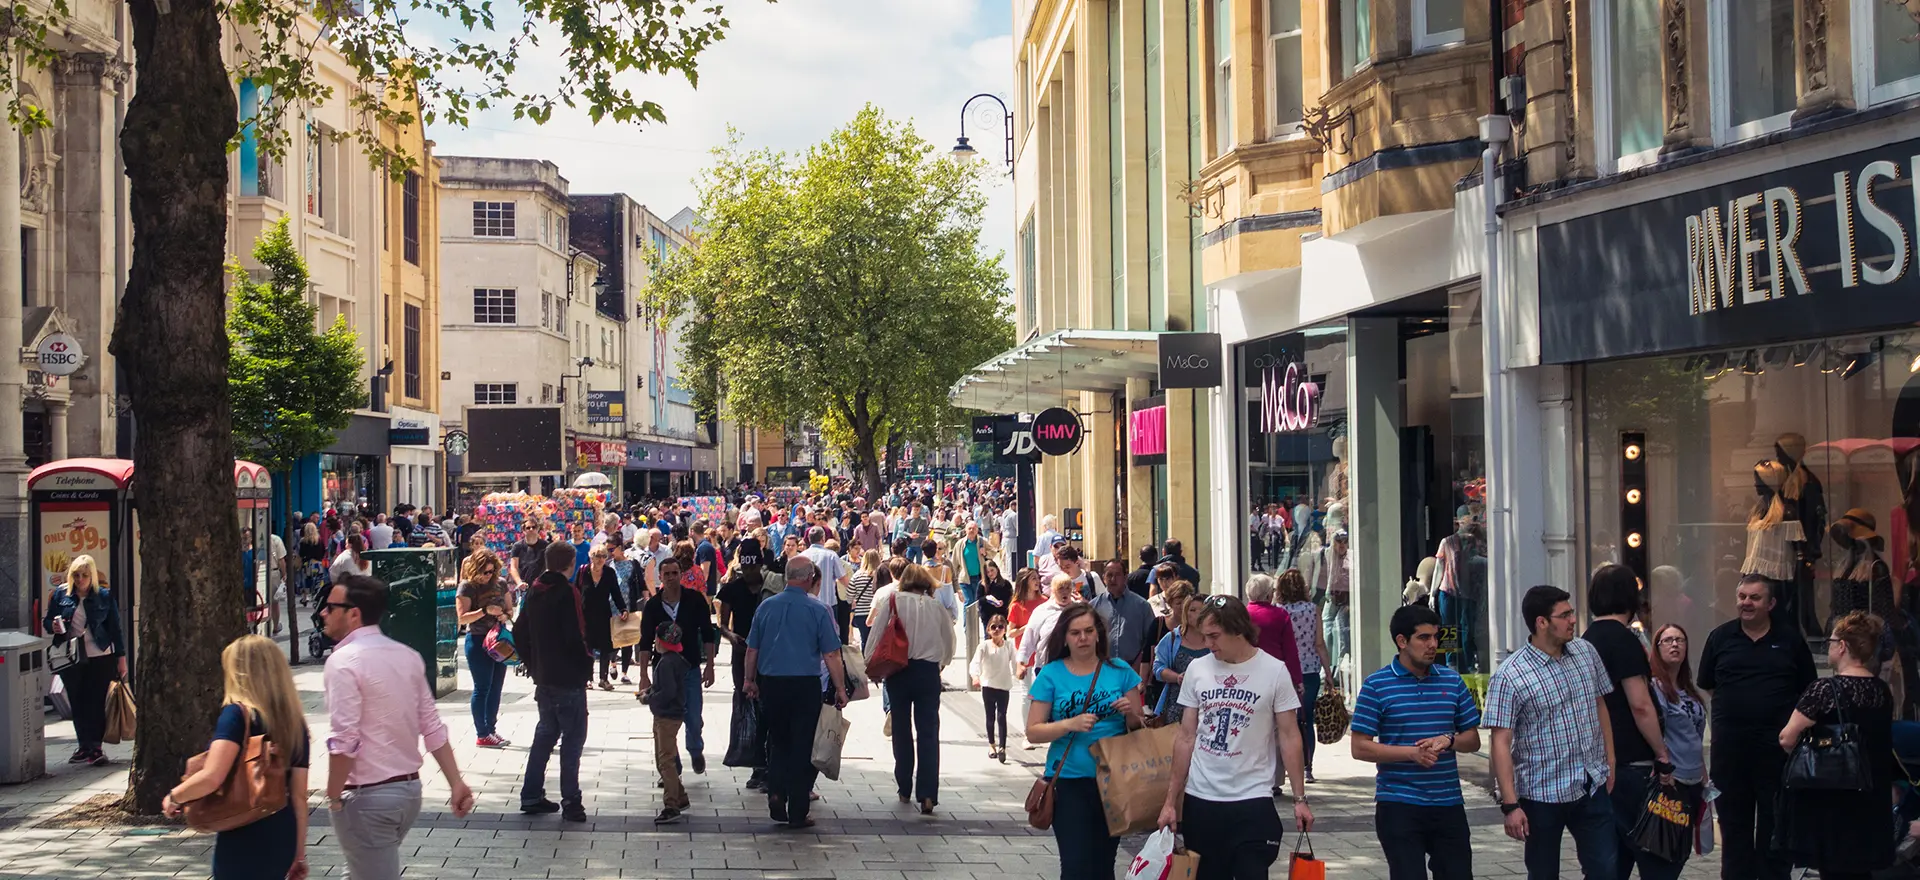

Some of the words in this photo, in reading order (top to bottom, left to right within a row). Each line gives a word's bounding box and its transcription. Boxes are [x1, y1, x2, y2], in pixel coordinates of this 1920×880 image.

[1685, 186, 1813, 316] RIVER
[42, 353, 76, 364] HSBC
[1167, 354, 1209, 369] M&Co
[1261, 362, 1312, 433] M&Co
[1037, 424, 1076, 439] HMV
[1002, 431, 1036, 455] JD
[56, 476, 95, 486] Telephone
[51, 491, 69, 499] Coins
[78, 491, 99, 499] Cards
[44, 531, 67, 544] ONLY
[741, 555, 757, 565] BOY
[1440, 627, 1457, 641] 25
[1201, 688, 1261, 704] SUPERDRY
[1121, 755, 1173, 774] PRIMAR
